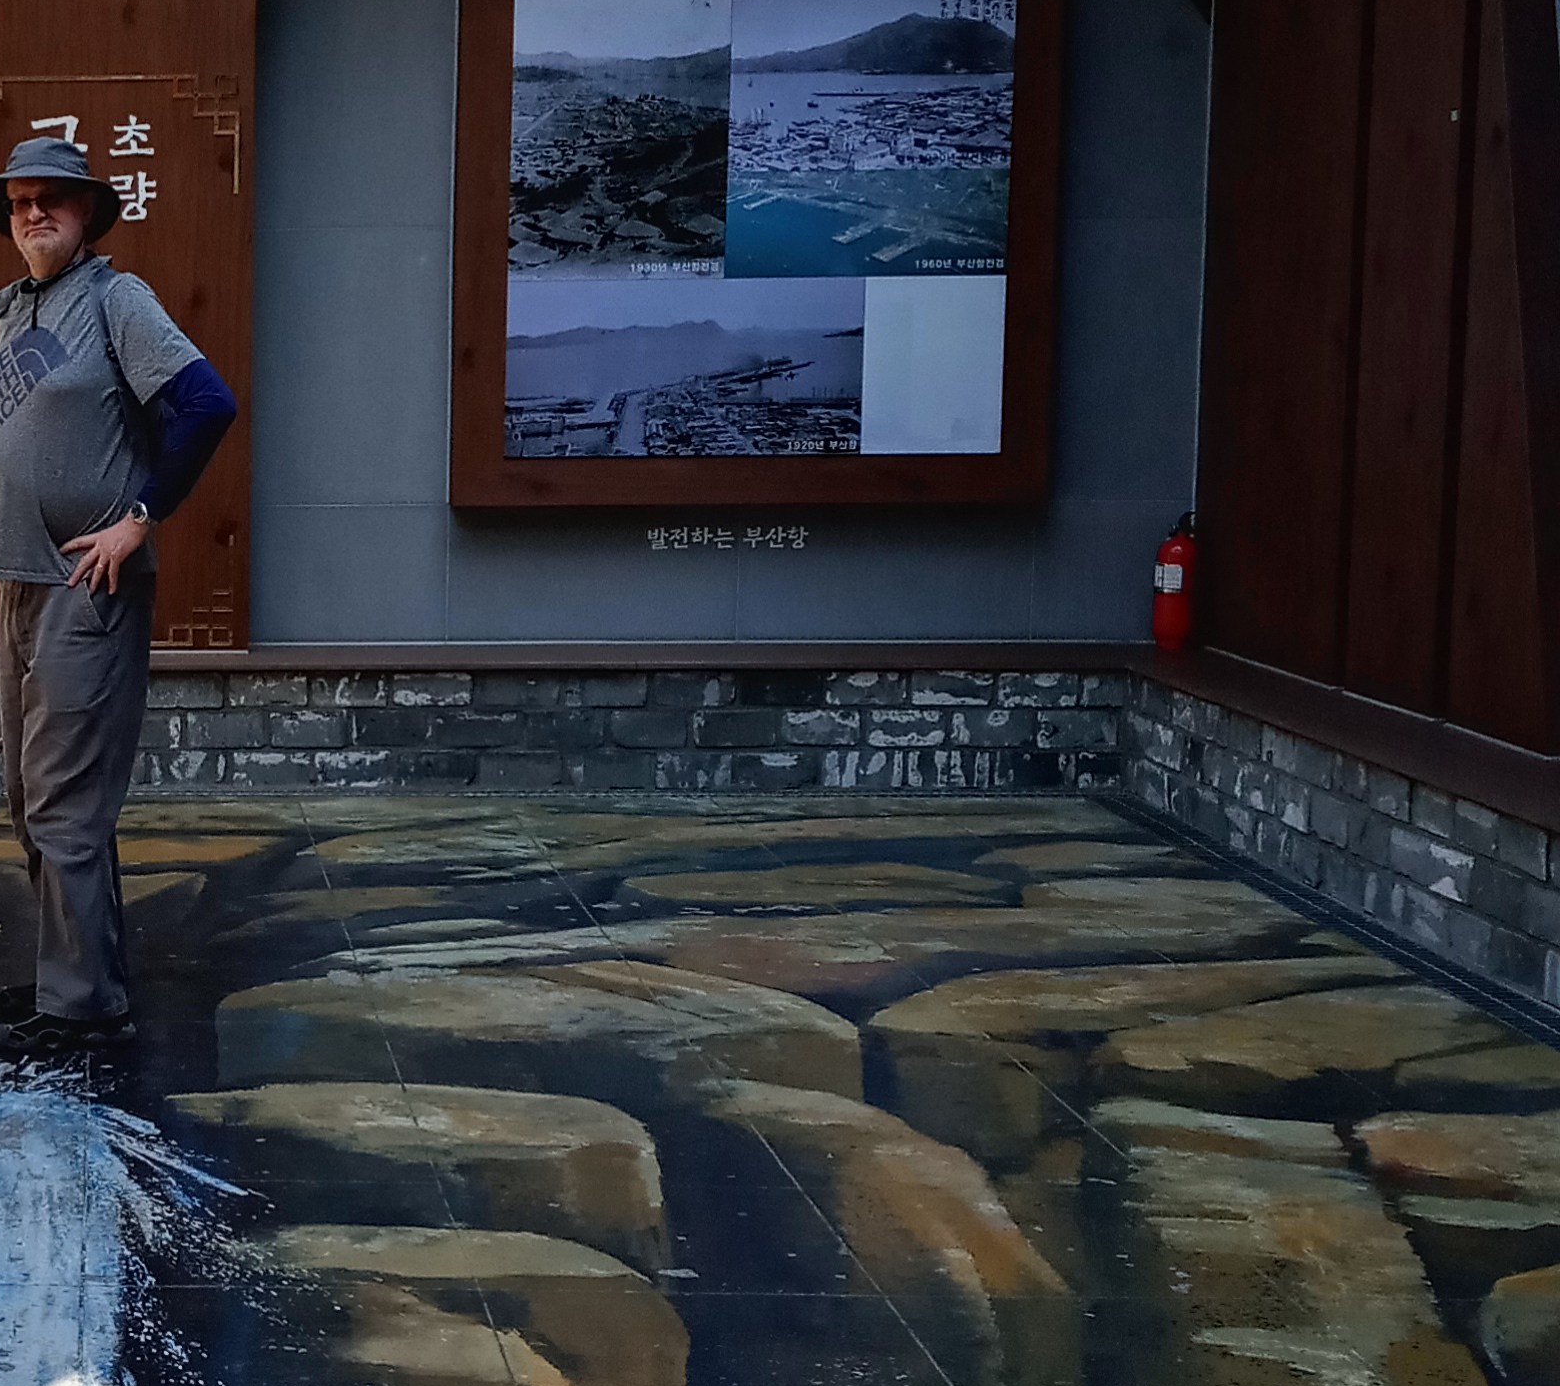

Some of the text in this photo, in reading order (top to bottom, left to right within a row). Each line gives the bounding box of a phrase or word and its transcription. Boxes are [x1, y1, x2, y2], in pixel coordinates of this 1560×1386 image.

[109, 115, 157, 222] 초량
[630, 262, 667, 273] 1930년
[915, 258, 952, 269] 1960년
[787, 440, 824, 451] 1920년
[646, 526, 809, 550] 발전하는 부산항
